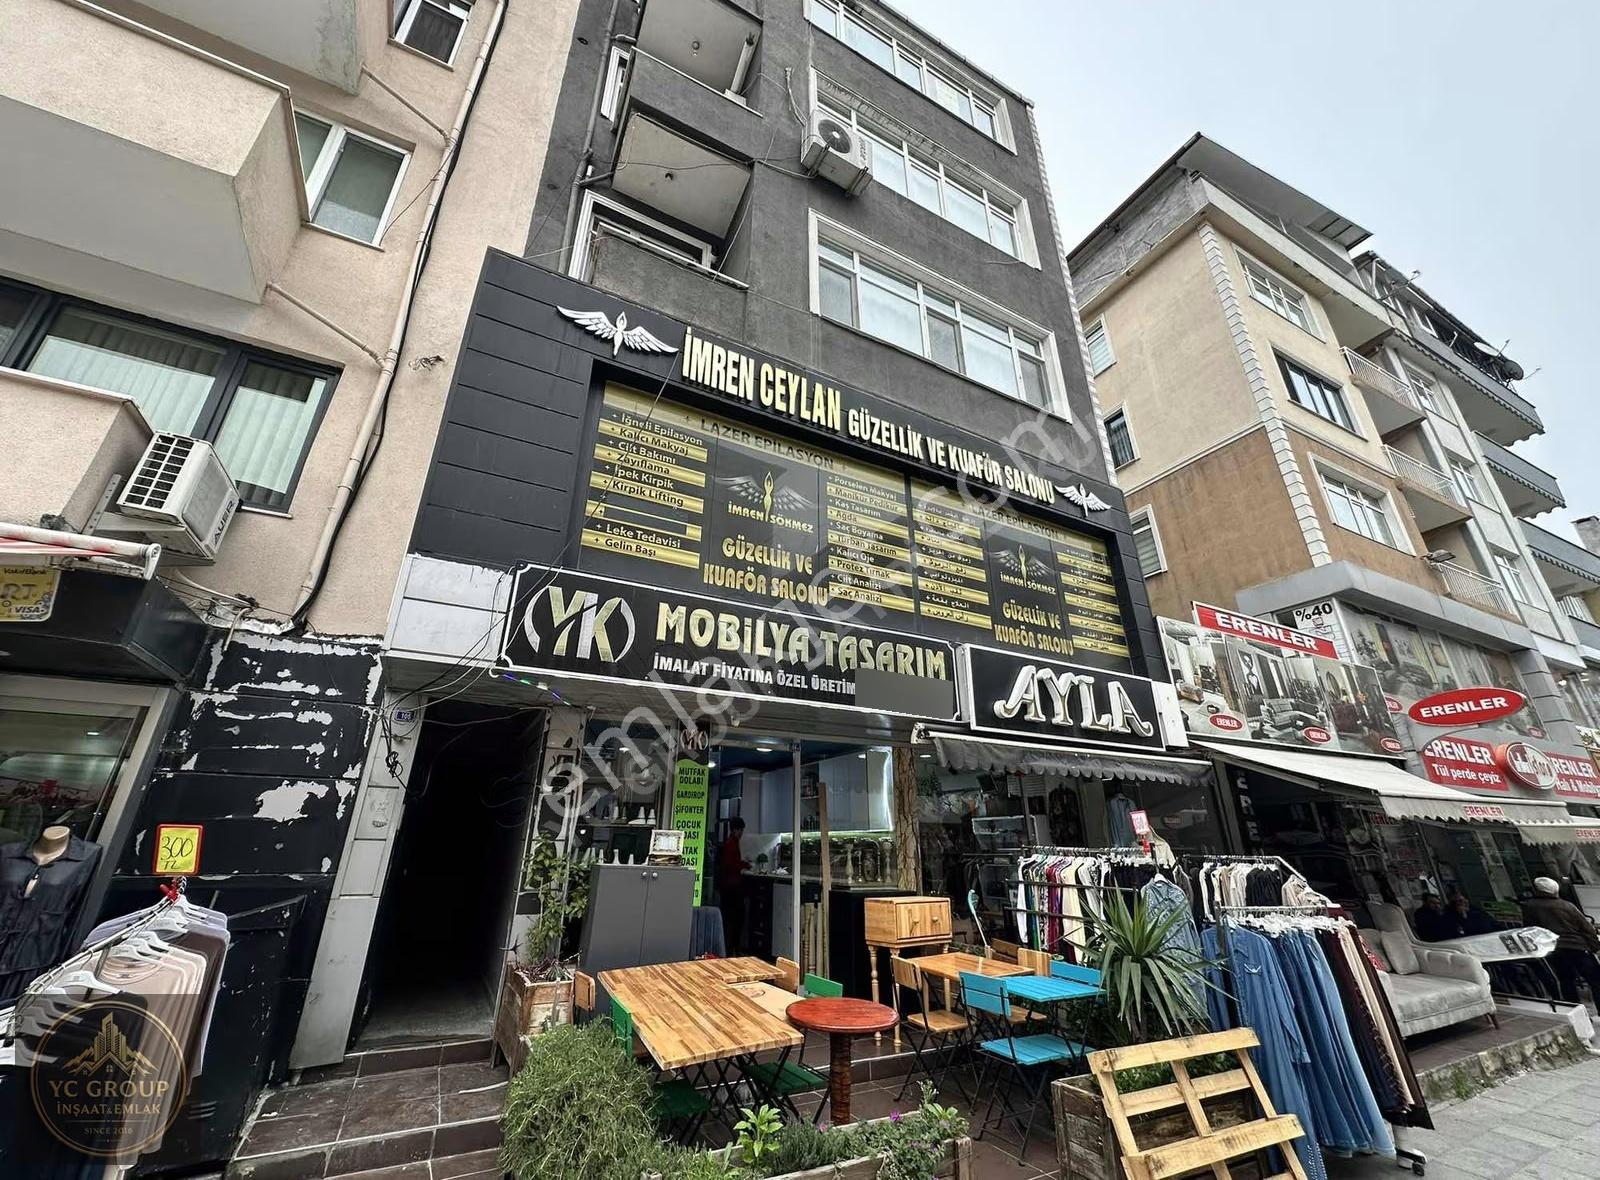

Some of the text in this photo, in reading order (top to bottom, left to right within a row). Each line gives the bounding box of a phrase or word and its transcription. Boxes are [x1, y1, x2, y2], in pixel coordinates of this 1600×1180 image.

[682, 326, 1056, 505] İMREN CEYLAN GÜZELLİK VE KUAFÖR SALONU
[654, 423, 703, 446] Epilasyon
[701, 418, 750, 445] LAZER
[639, 446, 676, 465] Bakımı
[651, 437, 690, 456] Makyaj
[616, 453, 670, 475] Zayıflama
[641, 474, 674, 491] Kirpik
[834, 475, 869, 492] Porselen
[612, 480, 684, 508] Kirpik Lifting
[606, 523, 681, 549] Leke Tedavisi
[835, 521, 883, 541] Saç Boyama
[605, 538, 632, 552] Gelin
[722, 534, 813, 575] GÜZELLİK VE
[837, 560, 864, 573] Protez
[703, 563, 828, 607] KUAFÖR SALONU
[837, 587, 882, 603] Saç Analizi
[853, 577, 882, 591] Analizi
[1002, 599, 1047, 627] GÜZELLİK
[1048, 613, 1062, 630] VE
[1295, 603, 1333, 622] %40
[994, 624, 1036, 648] KUAFÖR
[1037, 633, 1074, 656] SALONU
[1214, 612, 1320, 651] ERENLER
[820, 631, 947, 681] TASARIM
[653, 652, 709, 674] İMALAT
[712, 657, 773, 685] FİYATINA
[777, 670, 808, 689] ÖZEL
[994, 665, 1154, 737] AYLA
[1419, 696, 1509, 718] ERENLER
[678, 767, 706, 777] MUTFAK
[1431, 763, 1502, 784] Tül perde çeyiz
[1463, 805, 1504, 818] ERENLER
[676, 820, 702, 831] ÇOCUK
[160, 836, 194, 861] 300
